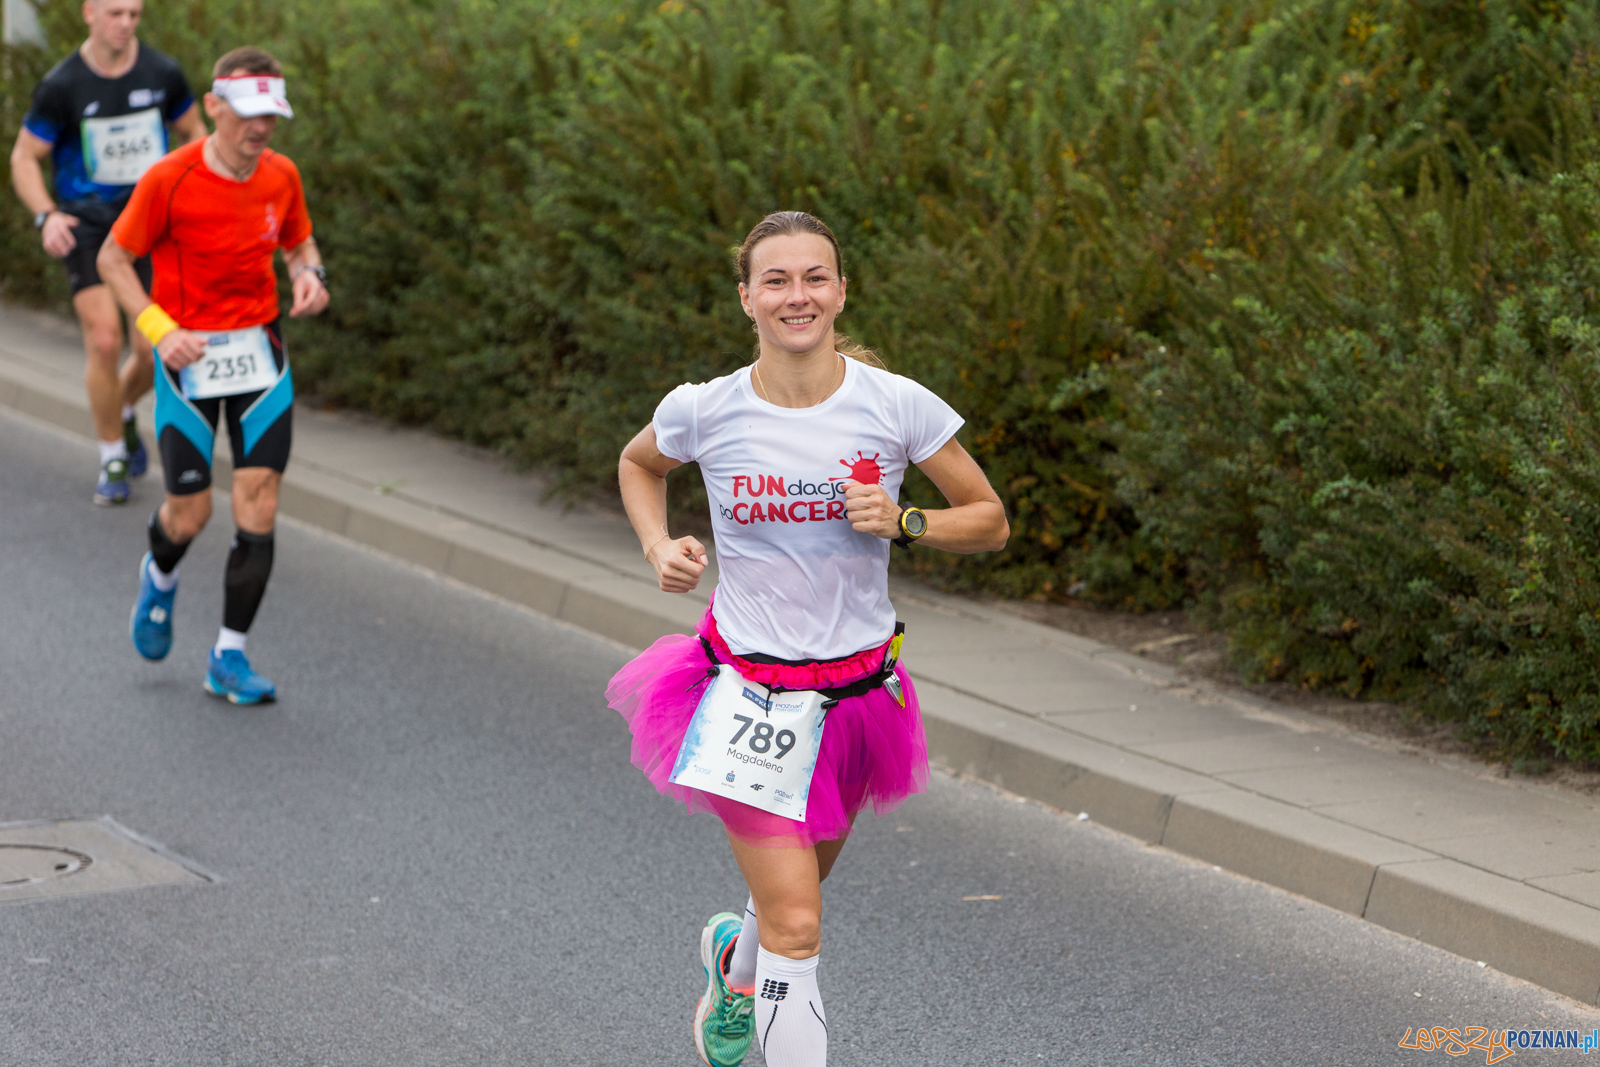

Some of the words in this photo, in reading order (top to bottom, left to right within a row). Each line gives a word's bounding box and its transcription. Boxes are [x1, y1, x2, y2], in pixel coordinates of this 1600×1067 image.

[205, 354, 257, 380] 2351
[729, 713, 796, 760] 789
[727, 747, 784, 774] Magdalena
[750, 783, 765, 792] 4F
